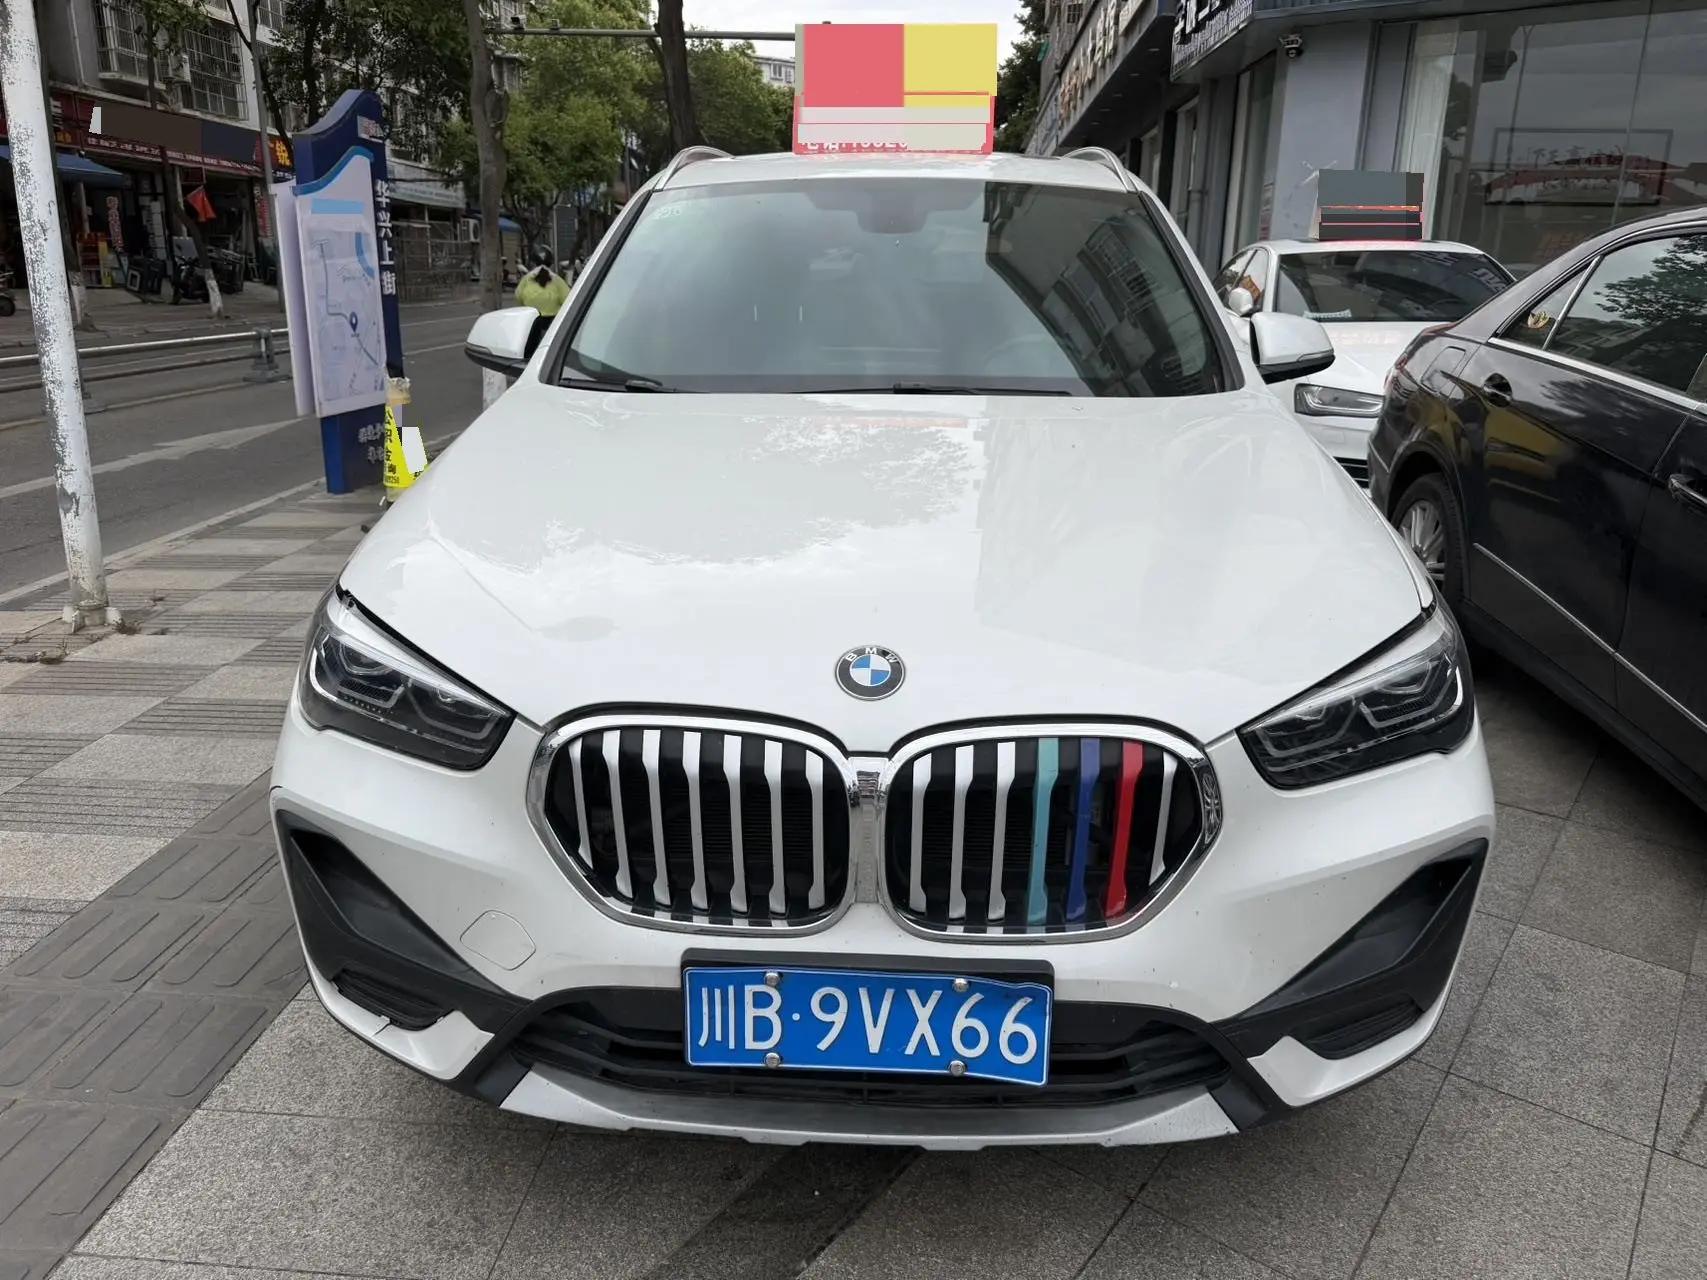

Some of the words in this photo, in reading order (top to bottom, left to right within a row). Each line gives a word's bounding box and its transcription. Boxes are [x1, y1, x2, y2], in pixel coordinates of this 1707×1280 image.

[375, 179, 397, 296] 华兴上街
[845, 647, 899, 663] BMW
